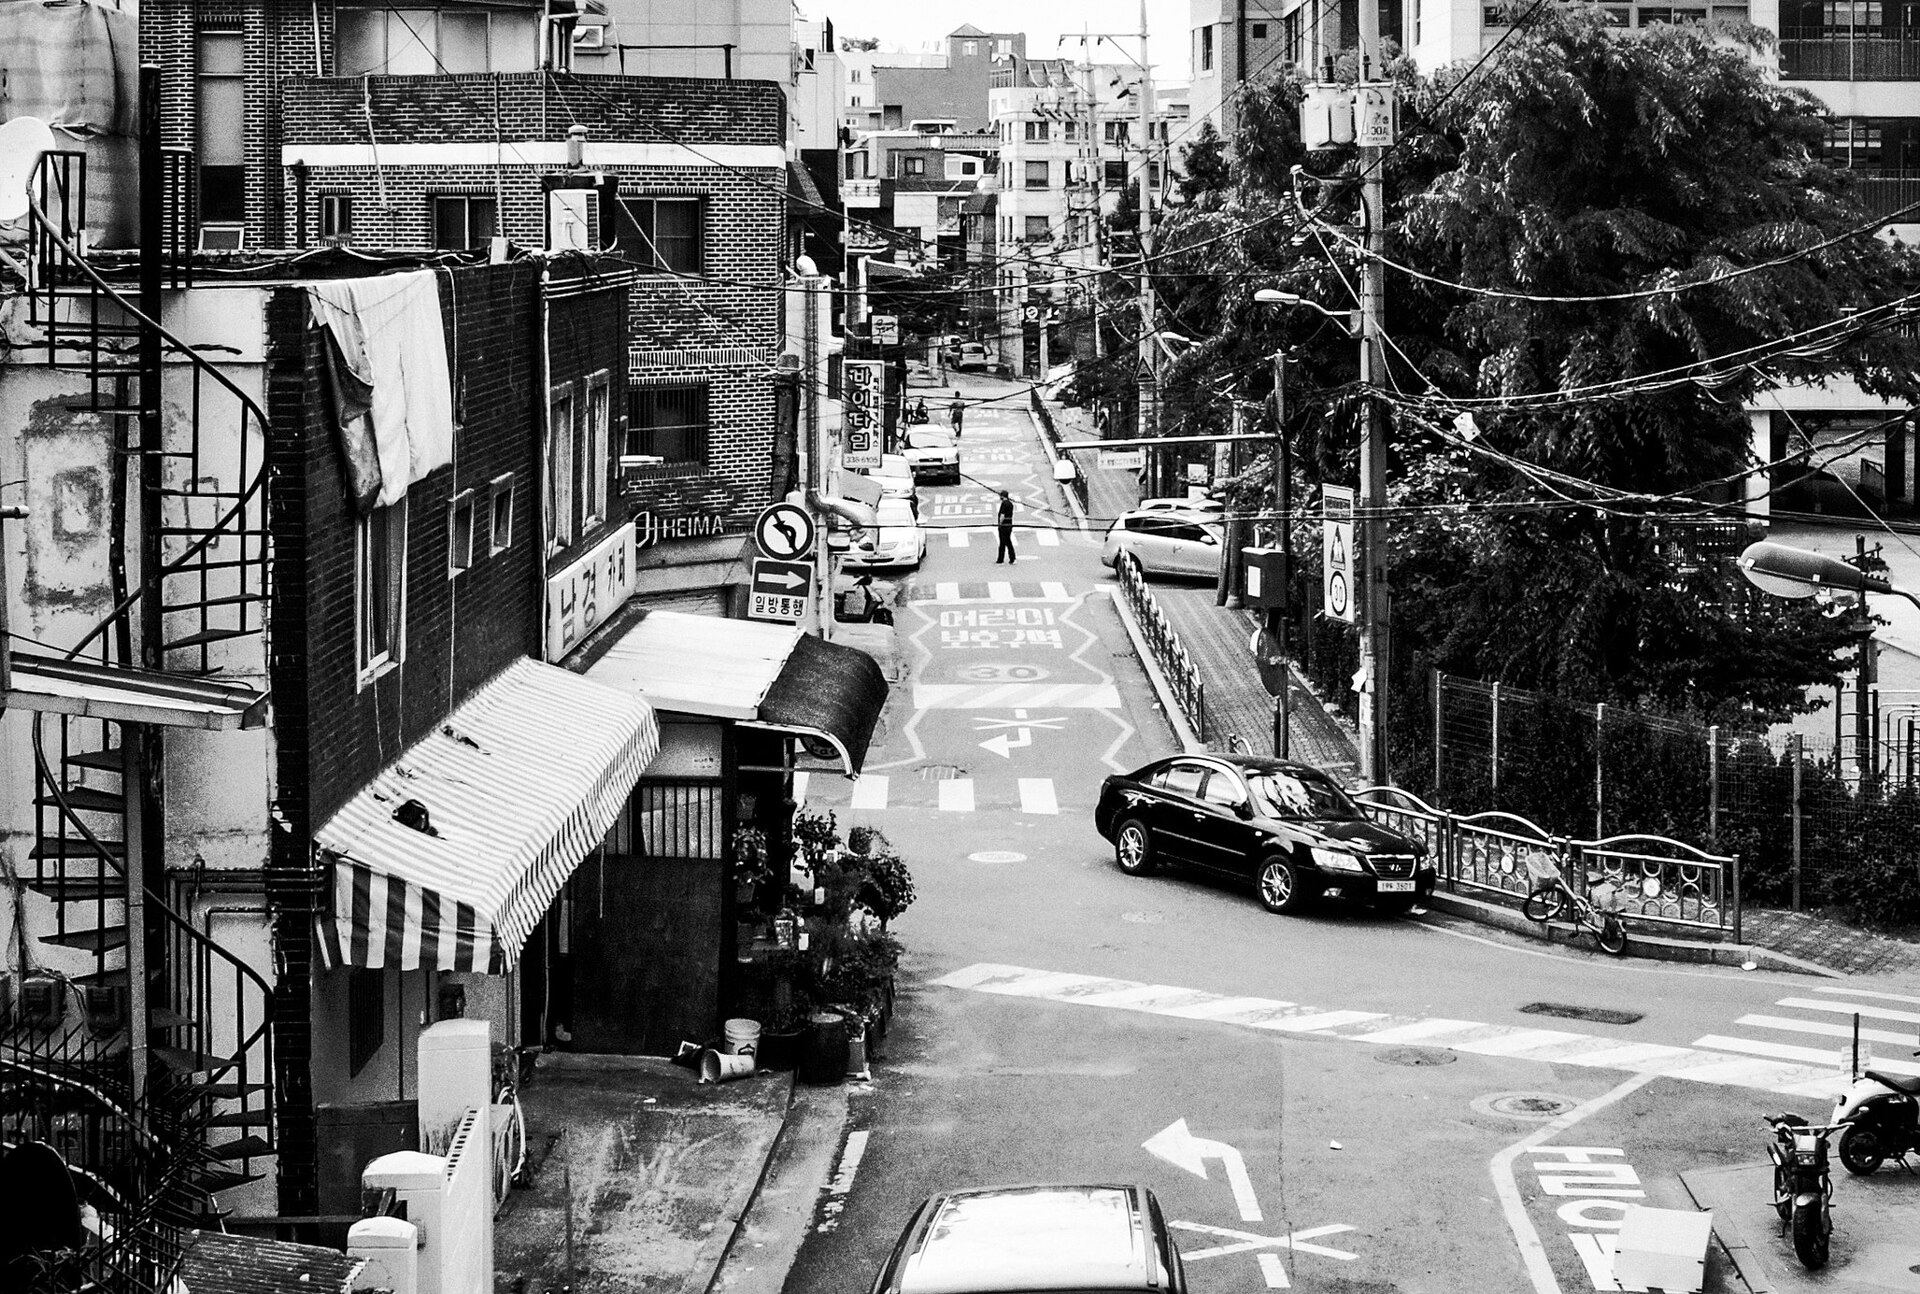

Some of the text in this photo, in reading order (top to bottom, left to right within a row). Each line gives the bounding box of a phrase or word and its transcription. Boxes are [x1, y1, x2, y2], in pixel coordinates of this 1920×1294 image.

[663, 515, 724, 538] HEIMA
[561, 561, 597, 649] 남경
[755, 595, 804, 617] 일방통행
[940, 608, 1056, 628] 어린이
[940, 629, 1063, 649] 보호구역
[968, 666, 1039, 680] 30
